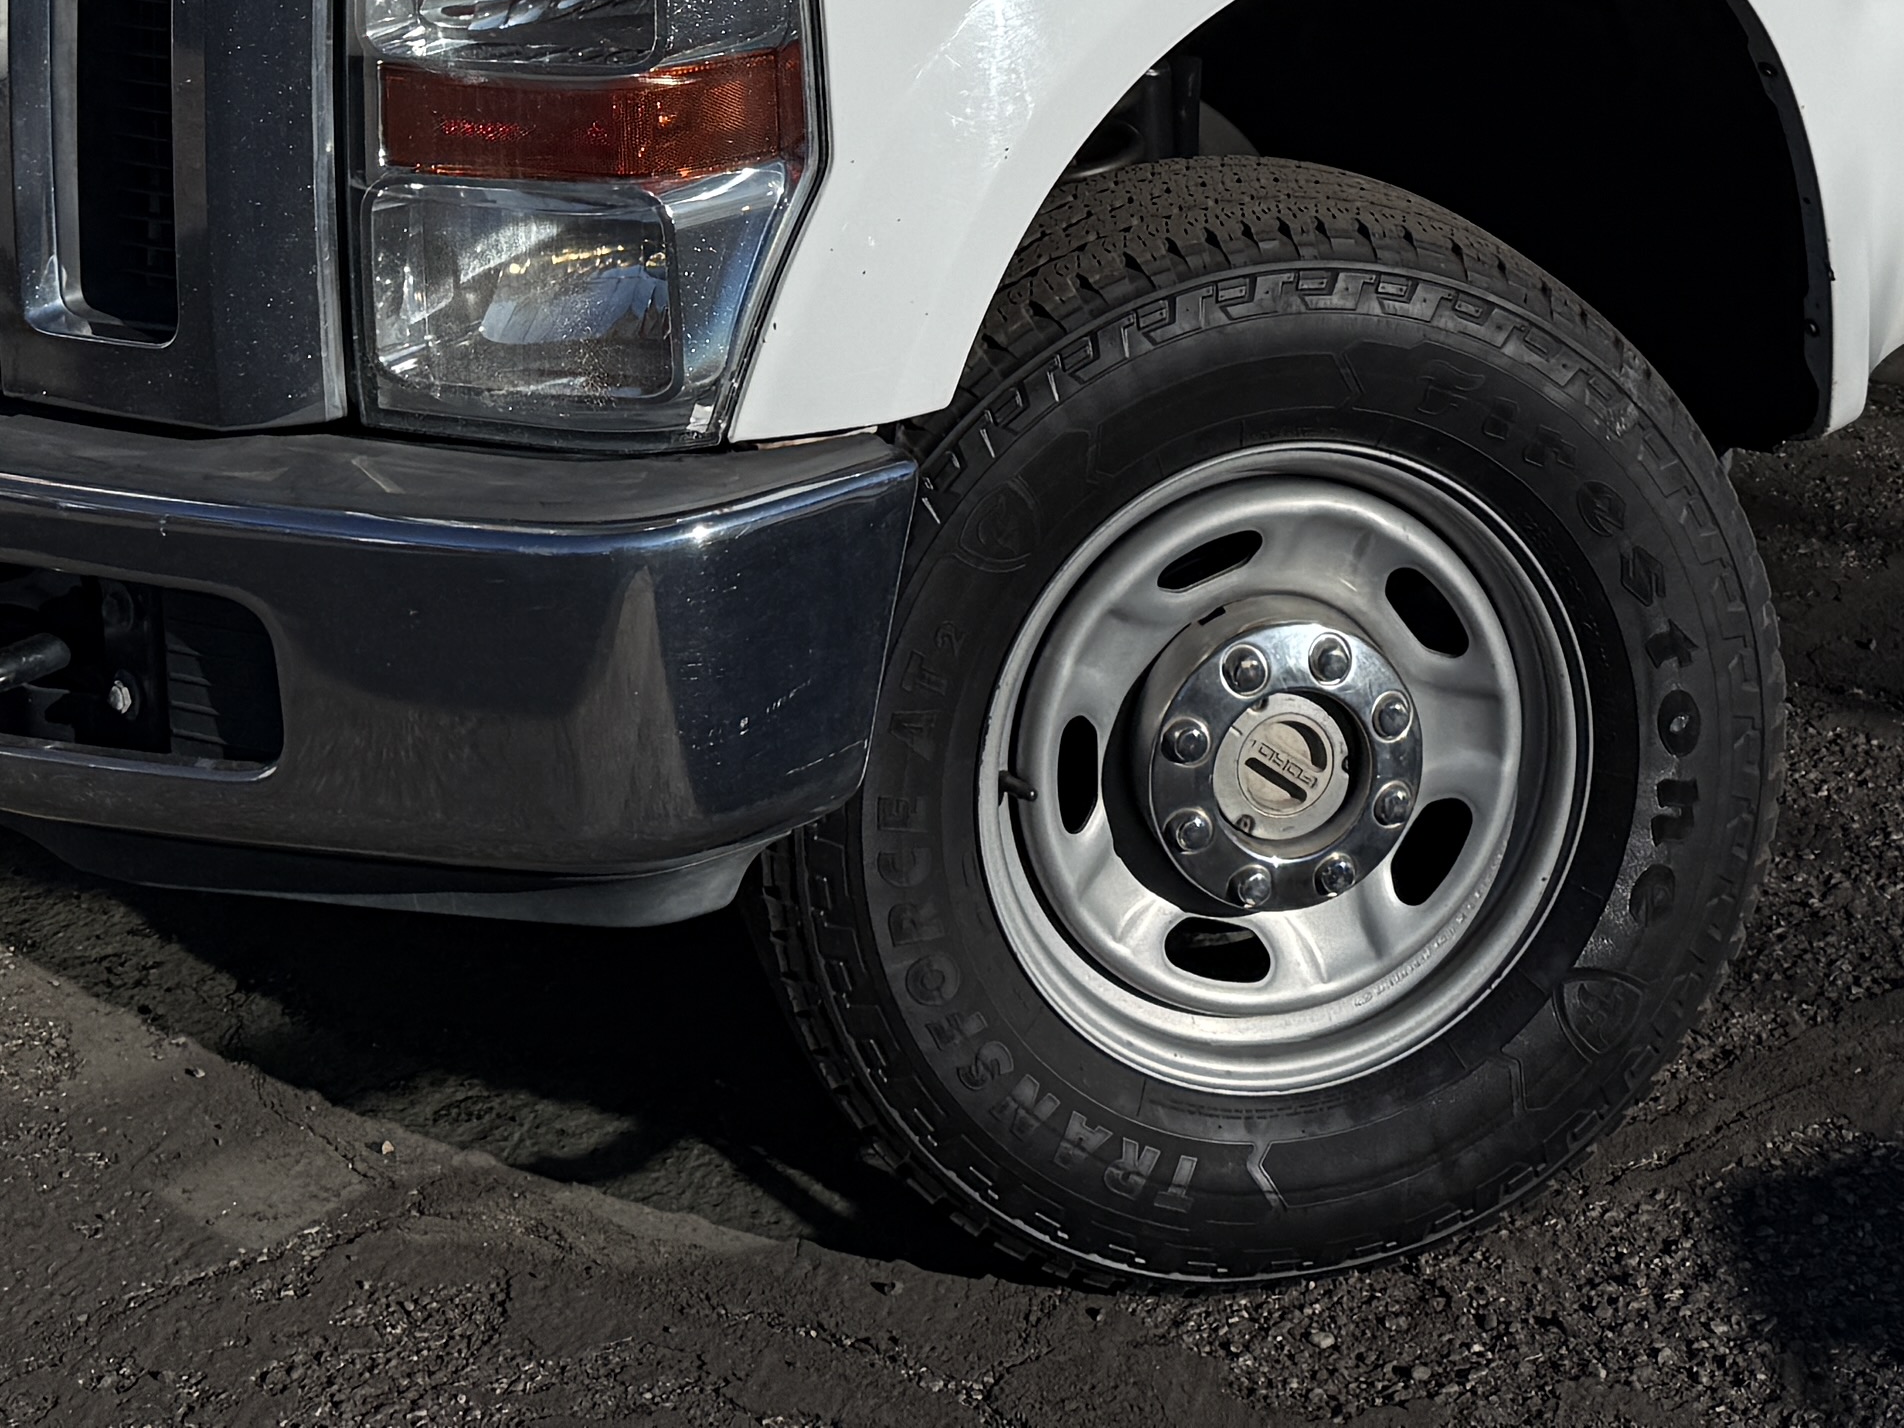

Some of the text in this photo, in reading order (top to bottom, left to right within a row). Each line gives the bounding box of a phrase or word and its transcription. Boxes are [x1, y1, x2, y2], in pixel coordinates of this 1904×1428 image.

[1257, 741, 1318, 789] FORD
[1421, 366, 1703, 927] Firestone
[872, 798, 1199, 1212] TRANSFORCE
